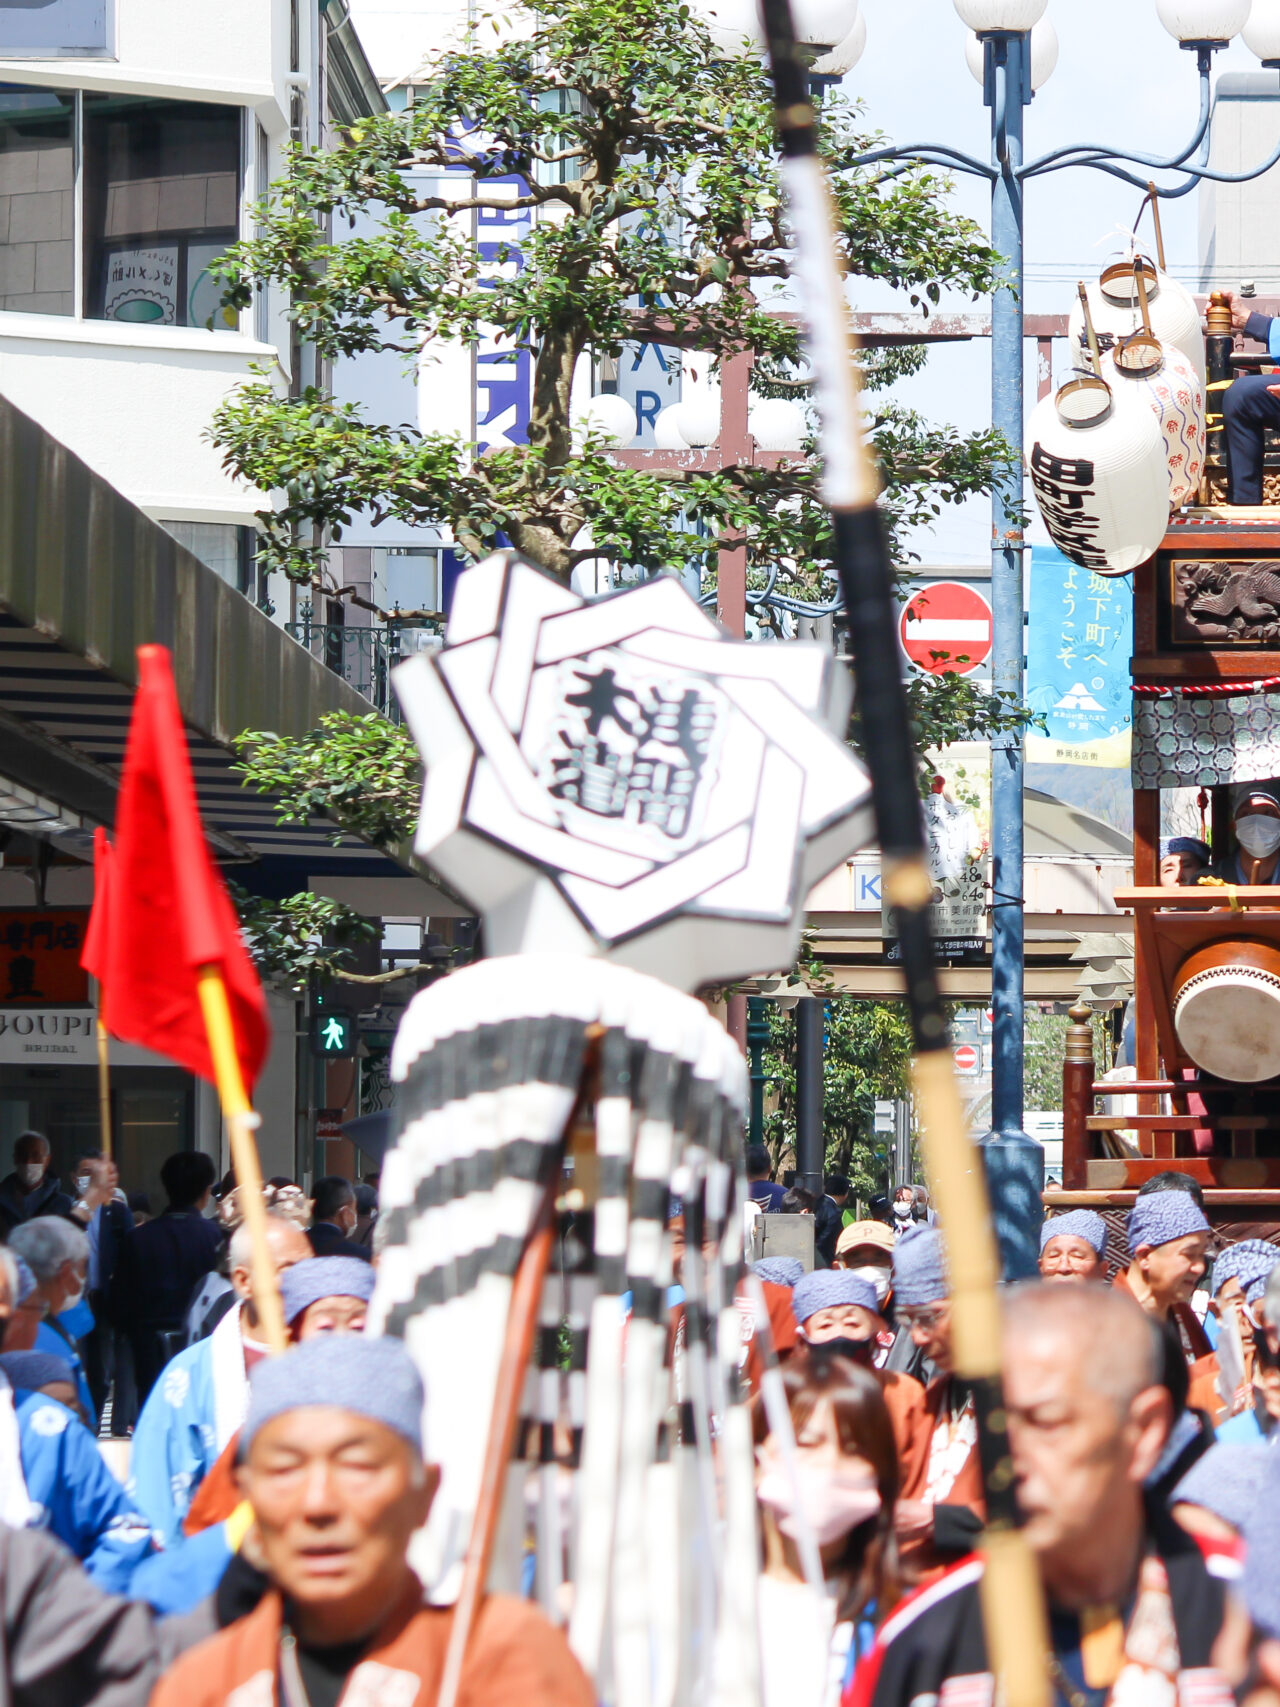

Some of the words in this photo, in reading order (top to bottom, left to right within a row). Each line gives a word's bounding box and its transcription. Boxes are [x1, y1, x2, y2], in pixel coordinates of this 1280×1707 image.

[1056, 567, 1079, 670] ようこそ
[1083, 571, 1114, 667] 城下町へ
[24, 1044, 78, 1054] BRIDAL
